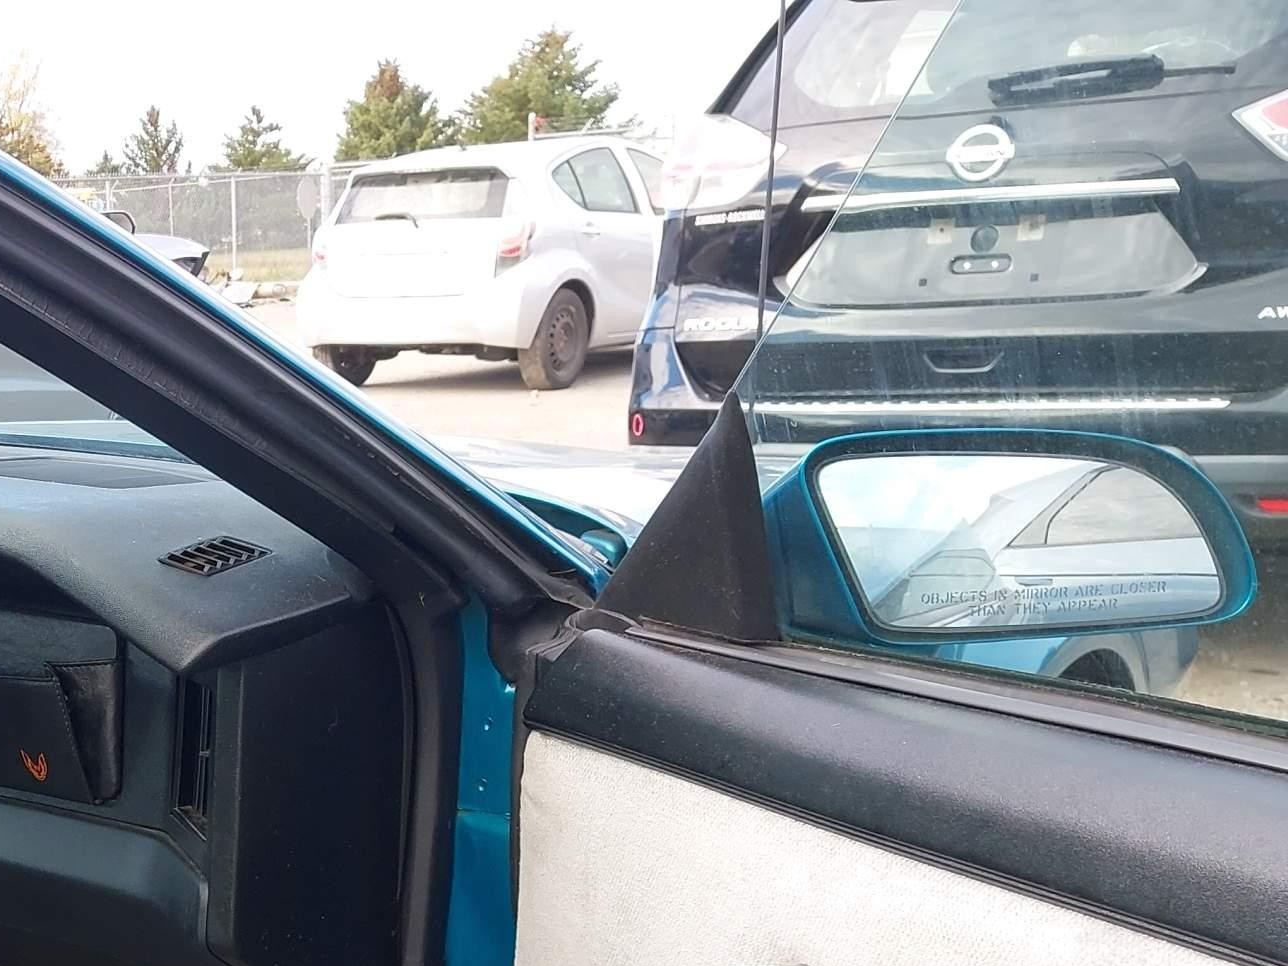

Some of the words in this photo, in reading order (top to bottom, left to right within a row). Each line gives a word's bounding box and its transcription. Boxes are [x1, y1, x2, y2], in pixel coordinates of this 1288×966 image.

[920, 589, 988, 606] OBJECTS
[993, 589, 1009, 600] IN
[1014, 585, 1069, 600] MIRROR
[1074, 583, 1104, 598] ARE
[1111, 580, 1168, 595] CLOSER
[968, 603, 1008, 617] THAN
[1014, 601, 1052, 615] THEY
[1056, 598, 1120, 613] APPEAR
